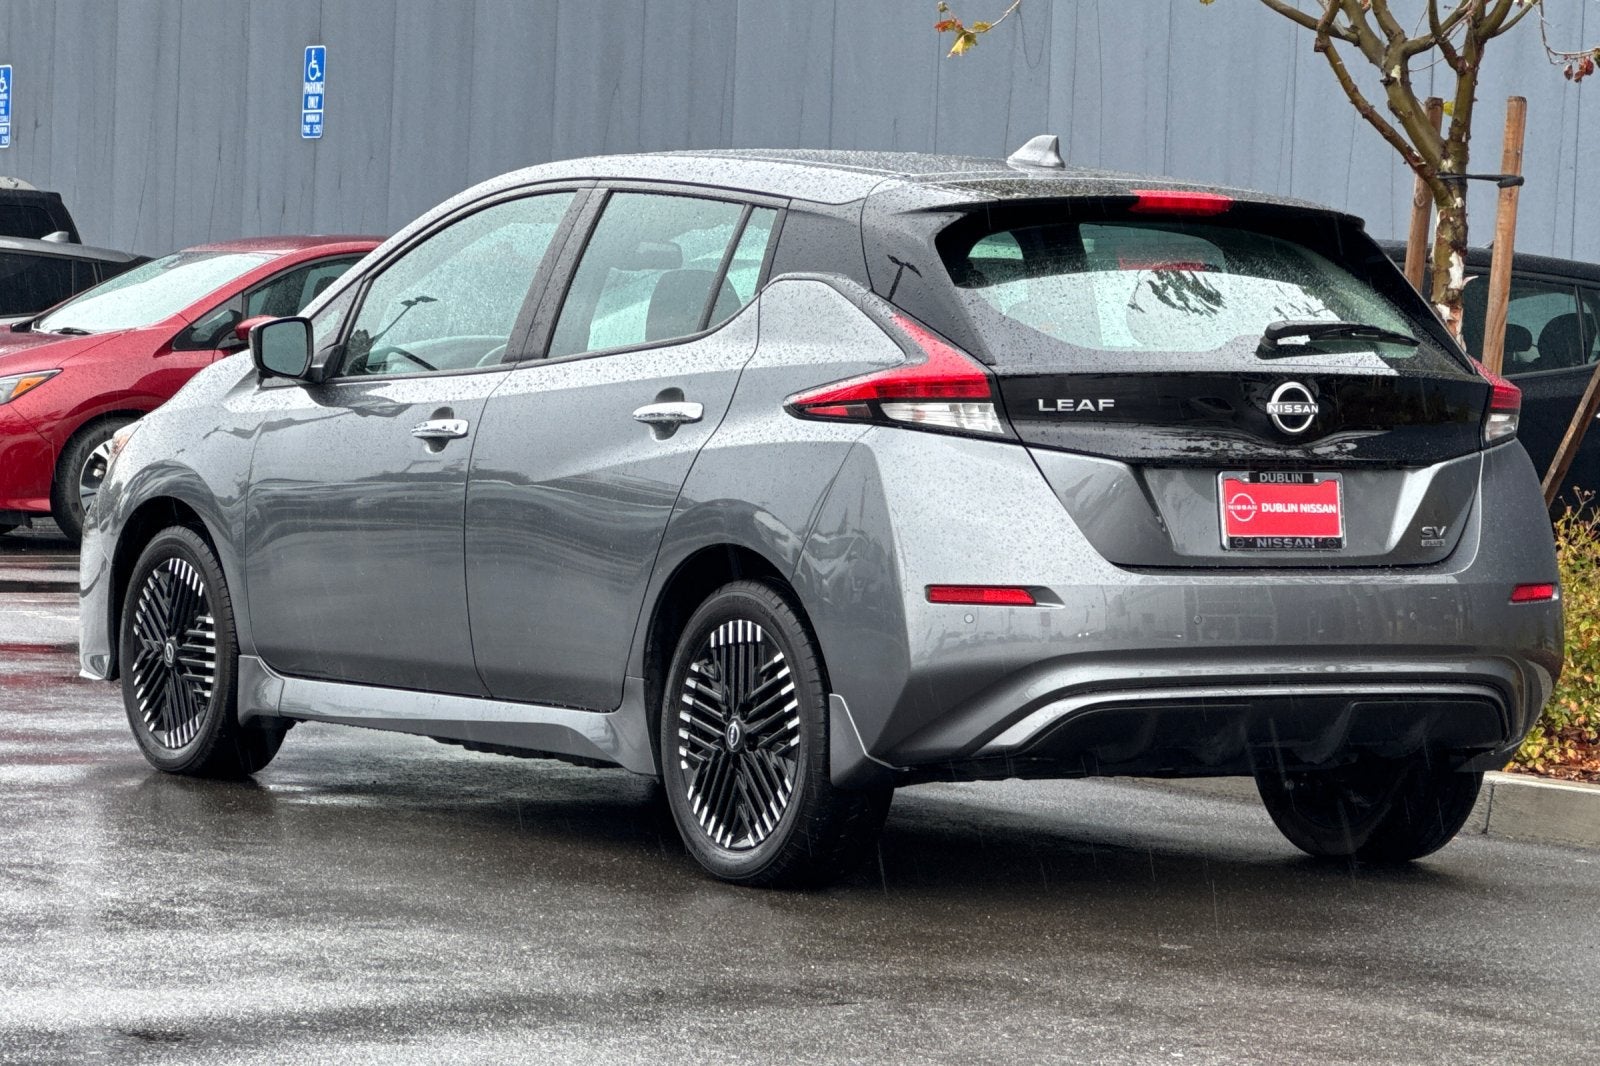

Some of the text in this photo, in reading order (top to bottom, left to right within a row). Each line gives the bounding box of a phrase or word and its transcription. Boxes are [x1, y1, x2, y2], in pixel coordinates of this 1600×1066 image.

[303, 82, 323, 94] PARKING
[307, 95, 320, 108] ONLY
[1037, 398, 1115, 412] LEAF
[1267, 404, 1319, 414] NISSAN
[1259, 473, 1304, 483] DUBLIN
[1261, 502, 1337, 513] DUBLIN NISSAN
[1421, 526, 1447, 538] SV
[1256, 537, 1315, 548] NISSAN
